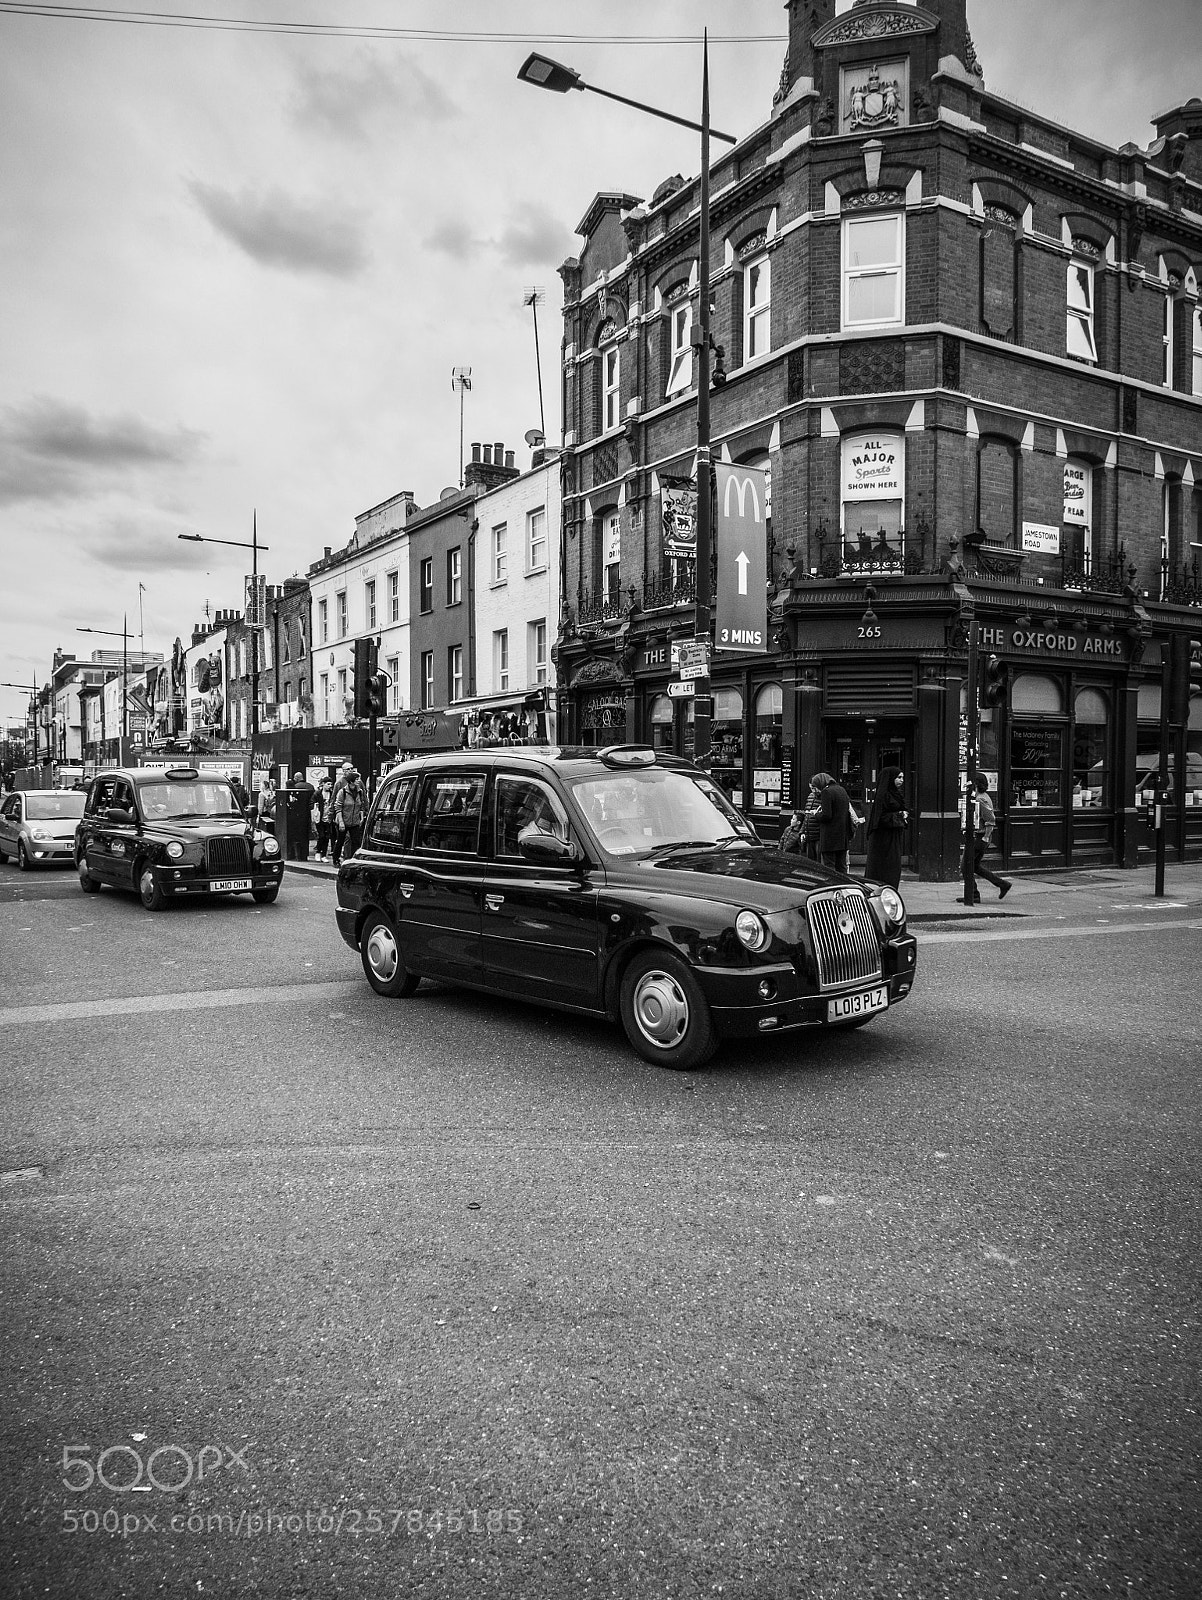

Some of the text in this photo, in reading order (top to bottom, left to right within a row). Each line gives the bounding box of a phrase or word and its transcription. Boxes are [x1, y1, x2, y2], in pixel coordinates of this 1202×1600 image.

[865, 441, 882, 450] ALL
[852, 452, 895, 467] MAJOR
[855, 465, 891, 480] Sports
[1063, 469, 1084, 481] ARGE
[847, 481, 898, 490] SHOWN HERE
[1063, 487, 1085, 498] arden
[1067, 507, 1085, 517] REAR
[1024, 529, 1058, 541] JAMESTOWN
[1024, 539, 1041, 548] ROAD
[721, 628, 762, 644] 3 MINS
[857, 626, 881, 638] 265
[979, 627, 1122, 655] HE OXFORD ARMS
[644, 648, 665, 665] THE
[1013, 730, 1022, 738] The
[1044, 731, 1060, 740] Family
[834, 989, 883, 1017] LO13 PLZ
